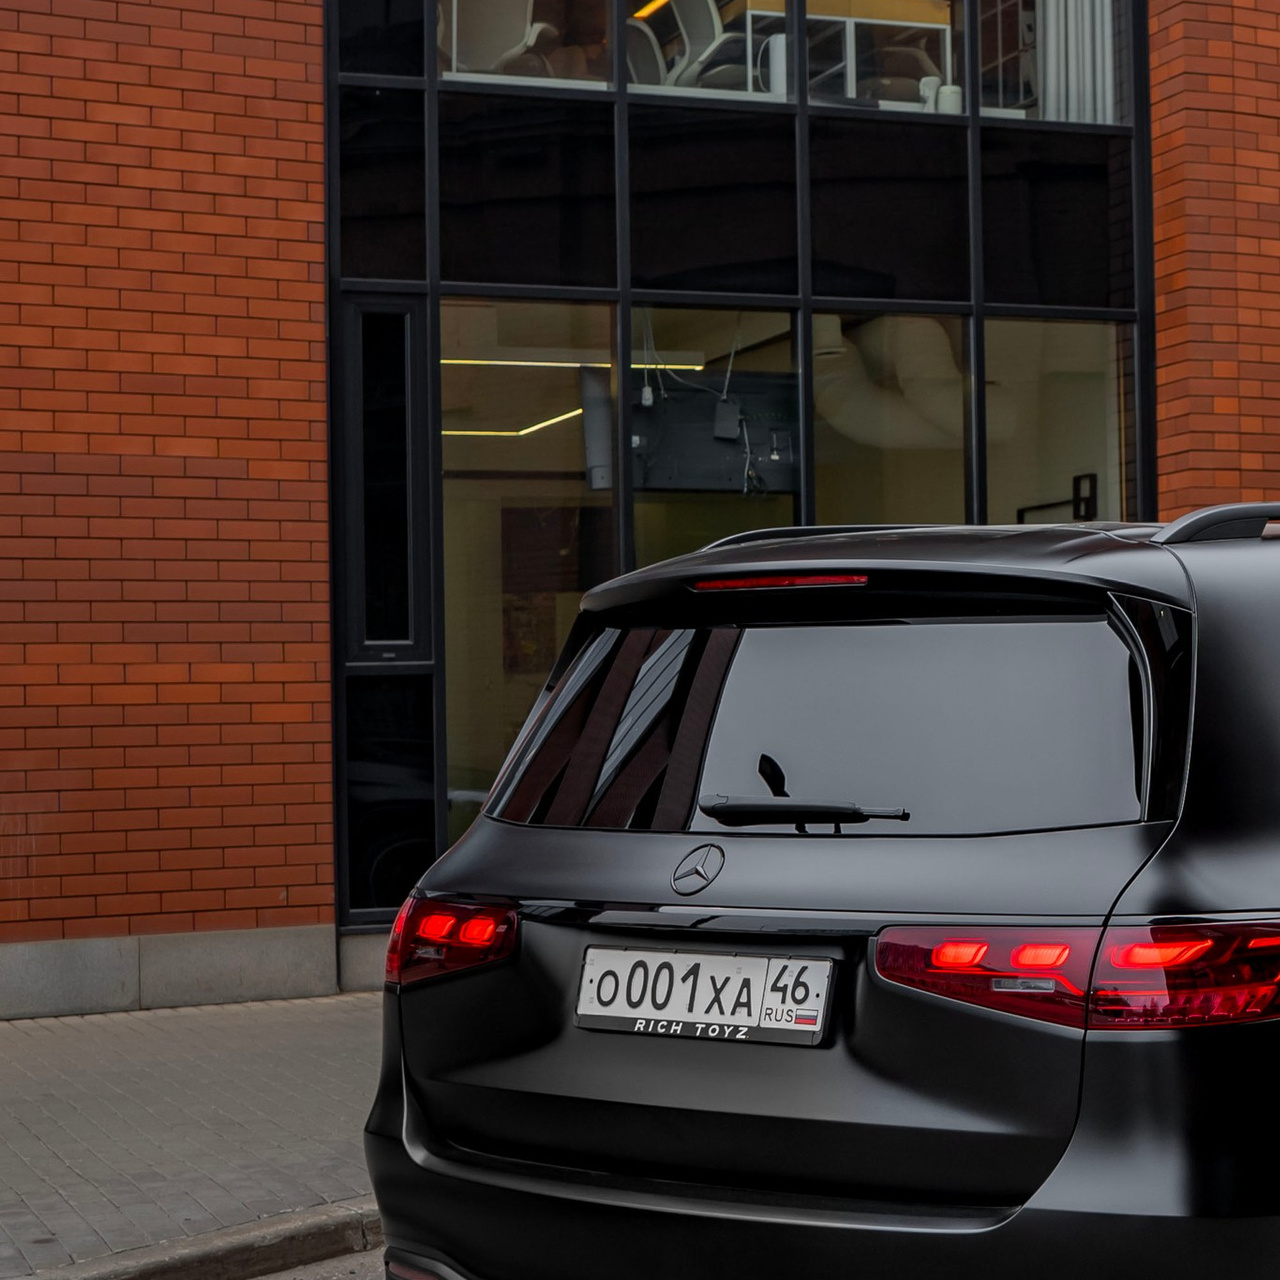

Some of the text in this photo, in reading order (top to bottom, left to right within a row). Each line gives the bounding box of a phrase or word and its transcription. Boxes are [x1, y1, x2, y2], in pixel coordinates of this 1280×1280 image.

[770, 964, 811, 1006] 46
[763, 1007, 794, 1024] RUS
[634, 1019, 683, 1035] RICH
